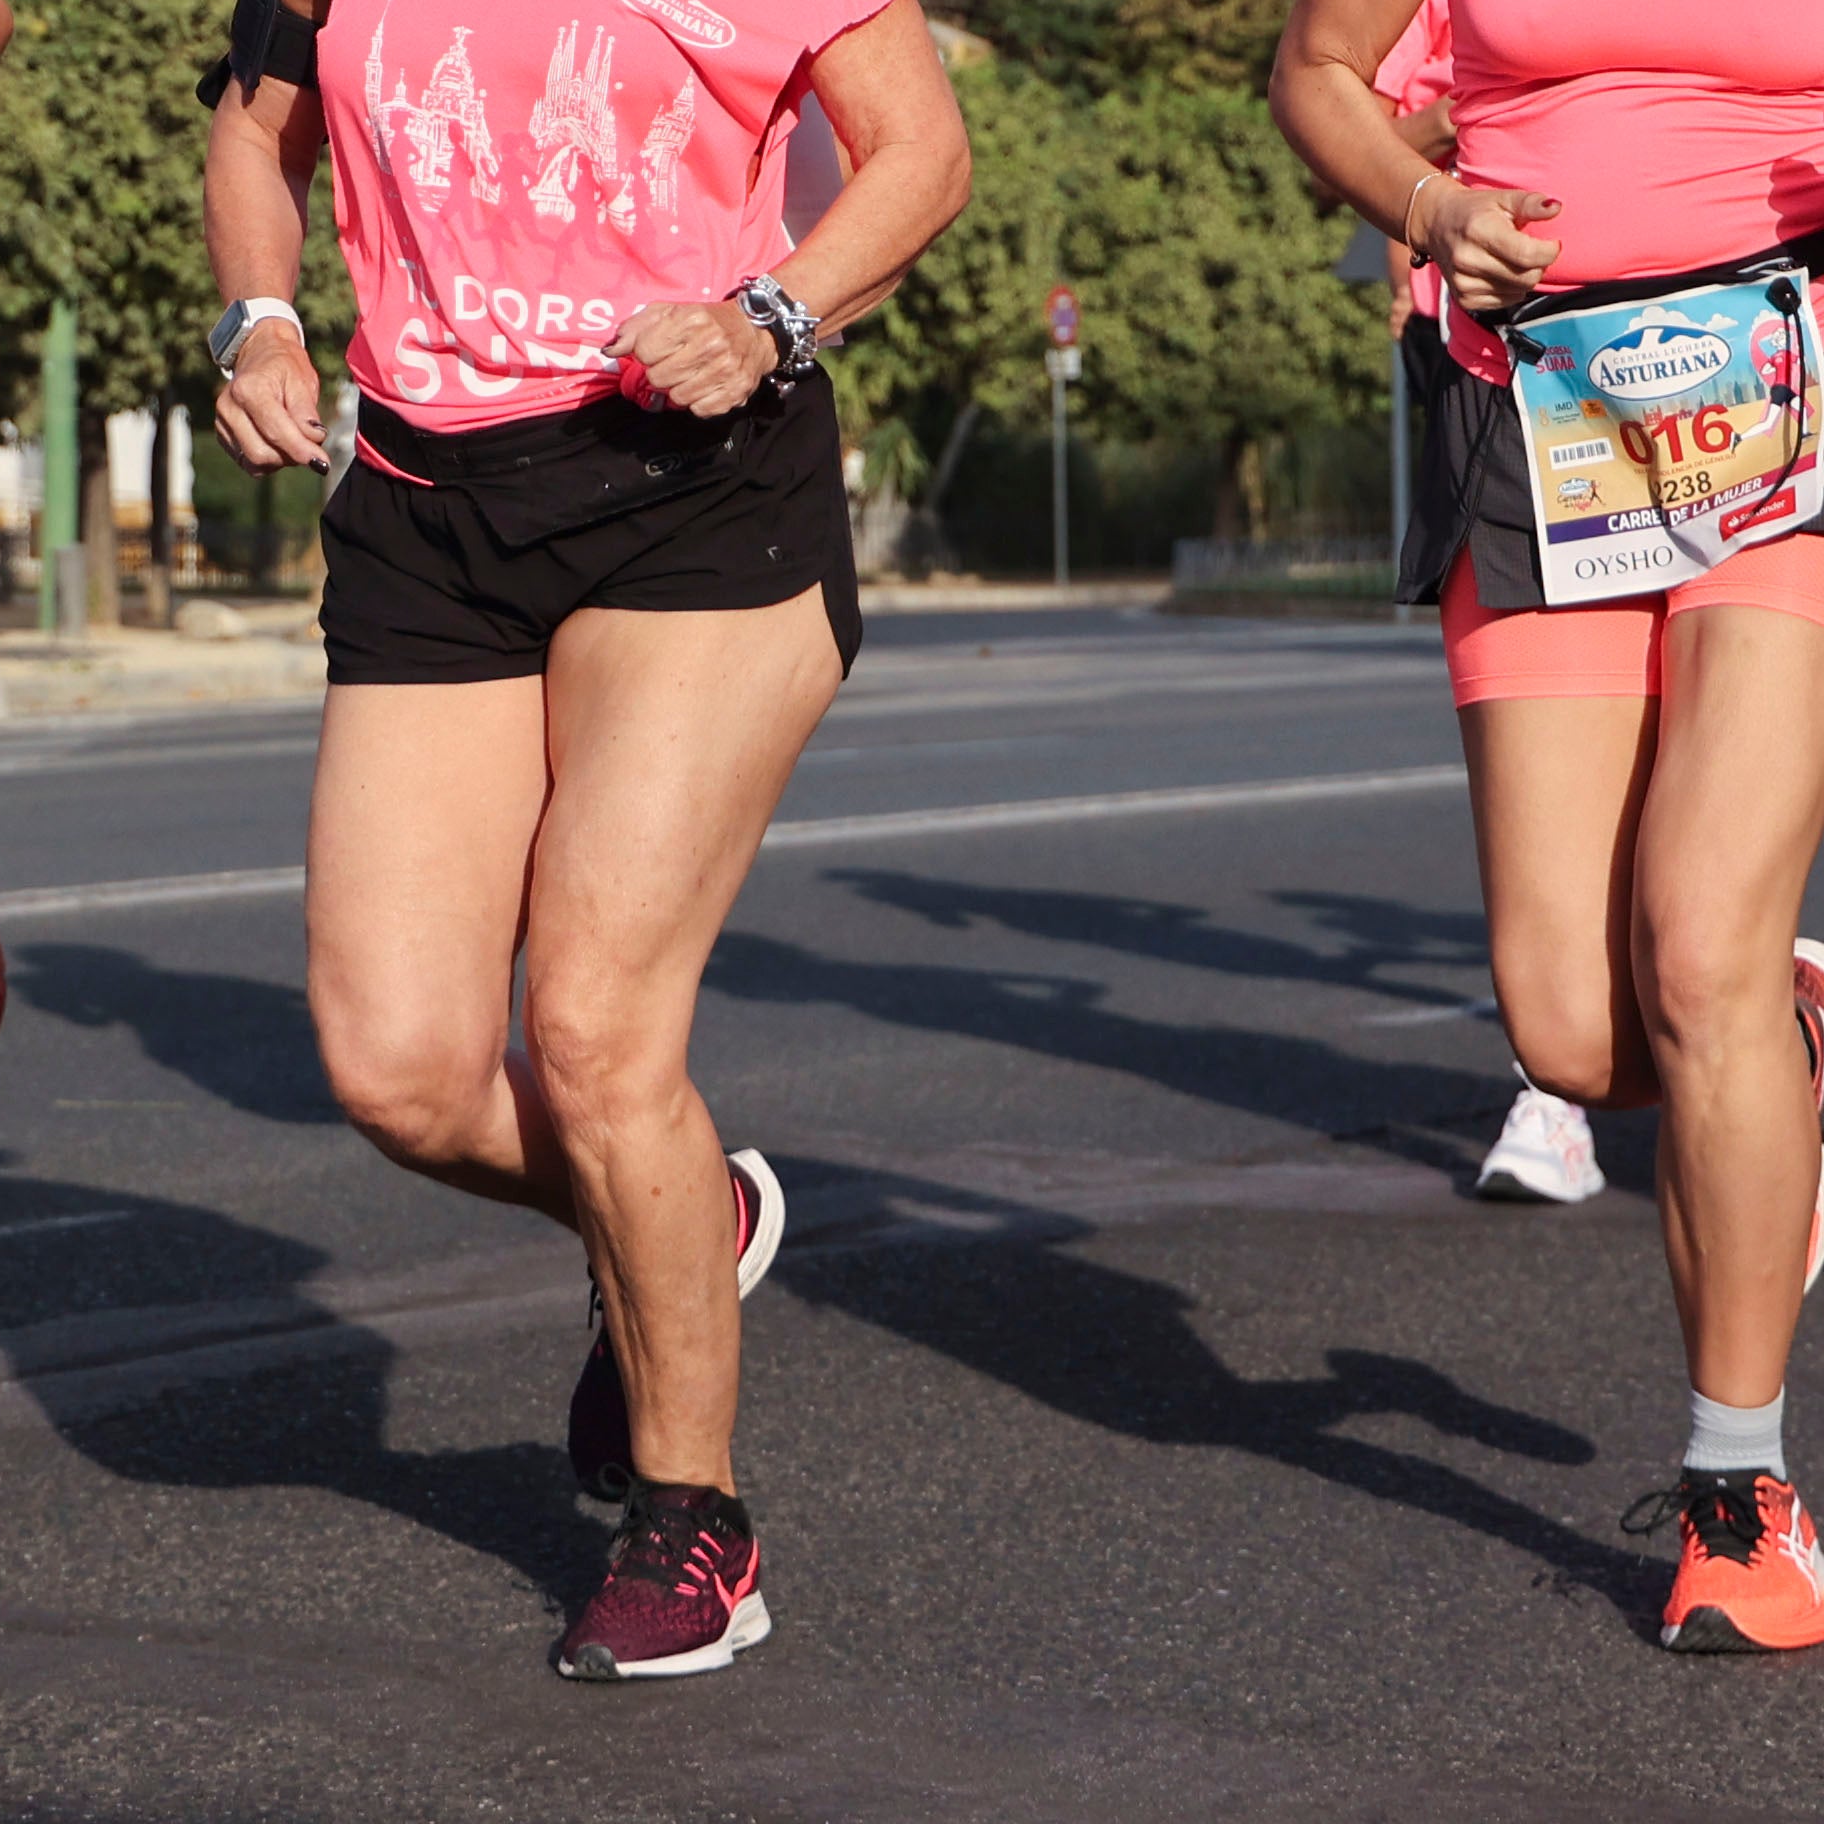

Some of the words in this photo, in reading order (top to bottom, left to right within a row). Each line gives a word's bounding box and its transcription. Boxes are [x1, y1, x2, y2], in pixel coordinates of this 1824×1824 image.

[1599, 349, 1722, 389] ASTURIANA
[1613, 352, 1659, 365] CENTRAL
[1619, 403, 1734, 465] 016
[1669, 506, 1688, 527] DE
[1692, 500, 1711, 516] LA
[1713, 477, 1763, 507] MUJER
[1575, 544, 1674, 580] OYSHO
